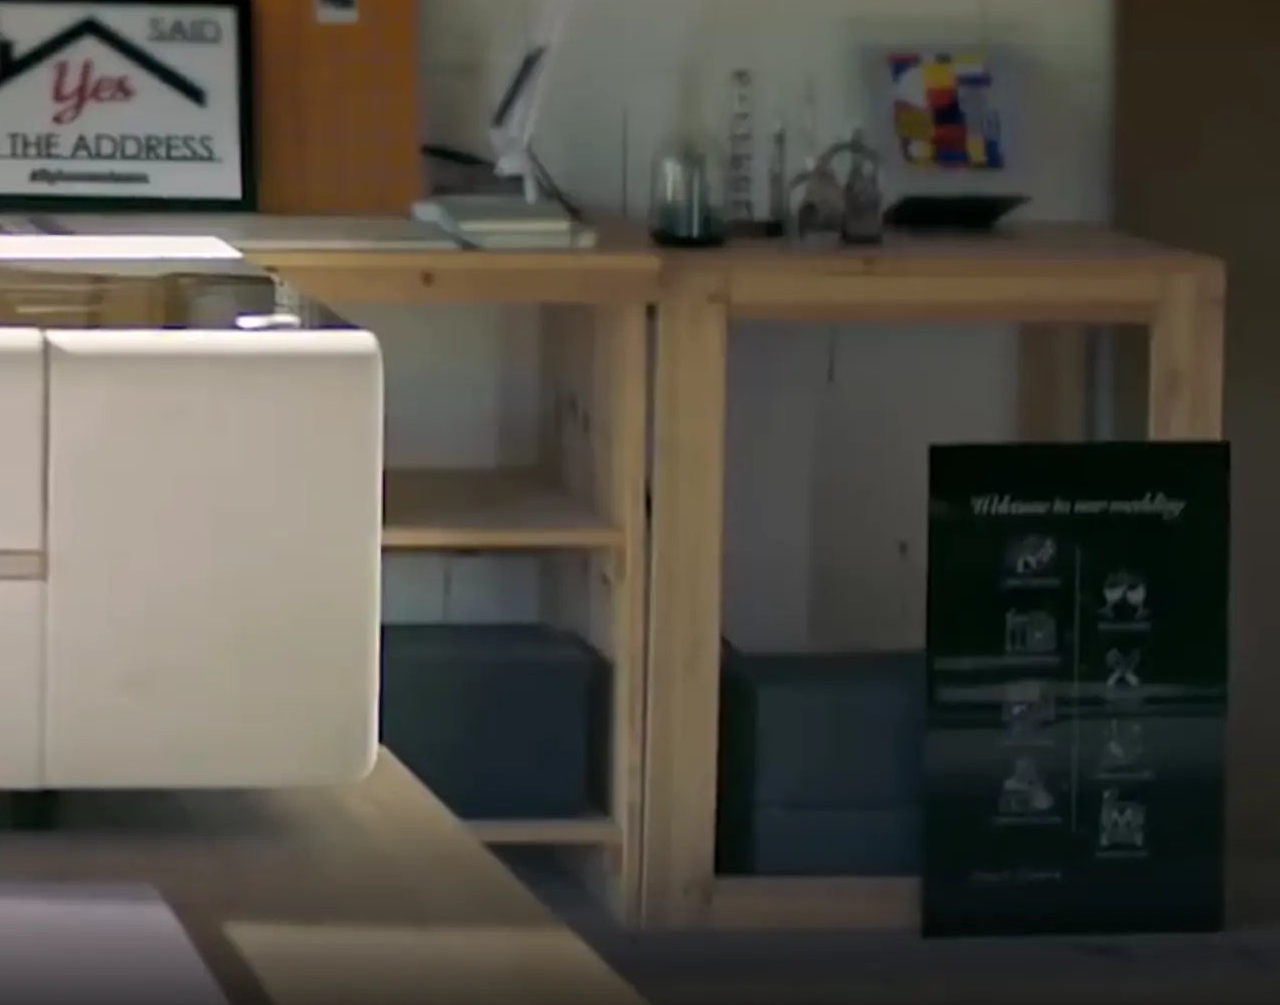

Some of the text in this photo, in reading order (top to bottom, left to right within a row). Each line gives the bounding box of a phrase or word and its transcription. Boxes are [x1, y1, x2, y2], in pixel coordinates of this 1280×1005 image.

[147, 17, 222, 44] SAID
[51, 59, 135, 125] Yes
[7, 133, 60, 159] THE
